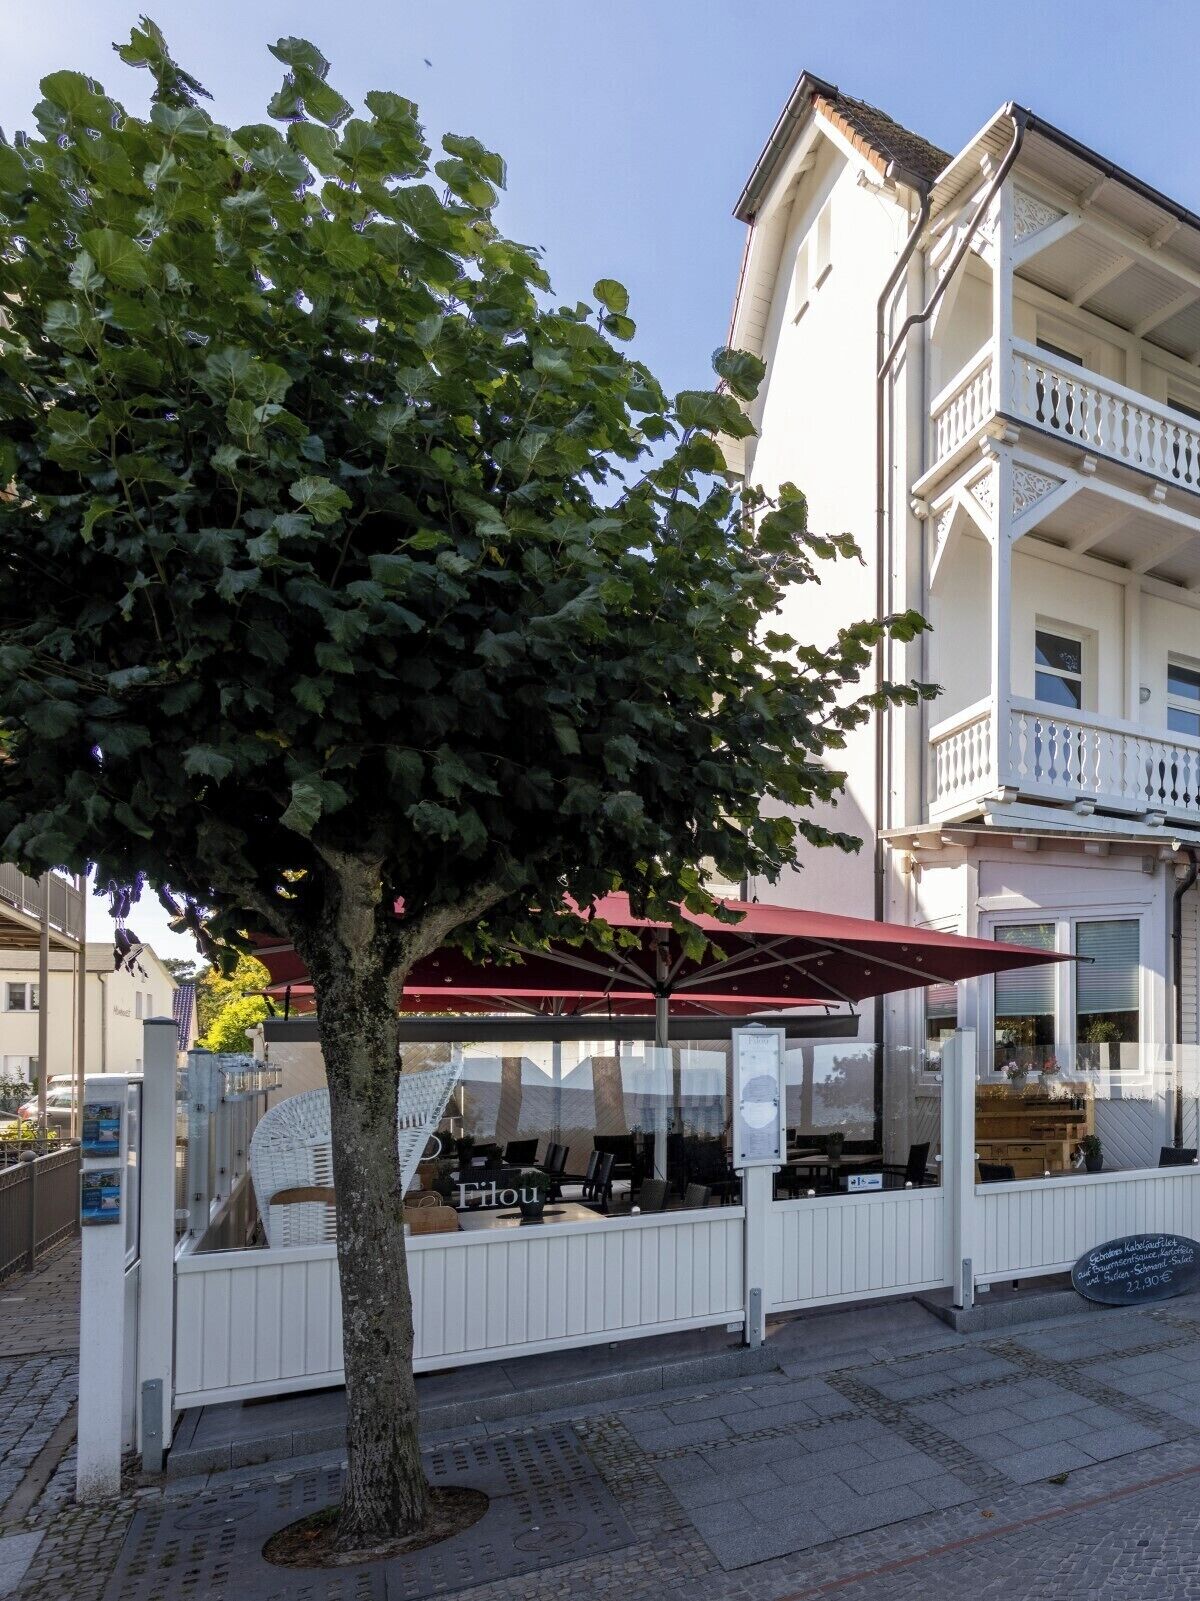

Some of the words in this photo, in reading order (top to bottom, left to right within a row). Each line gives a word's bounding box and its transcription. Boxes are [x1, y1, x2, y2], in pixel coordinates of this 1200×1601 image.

[456, 1180, 540, 1209] Filou
[1077, 1266, 1092, 1280] auf
[1086, 1275, 1101, 1287] und
